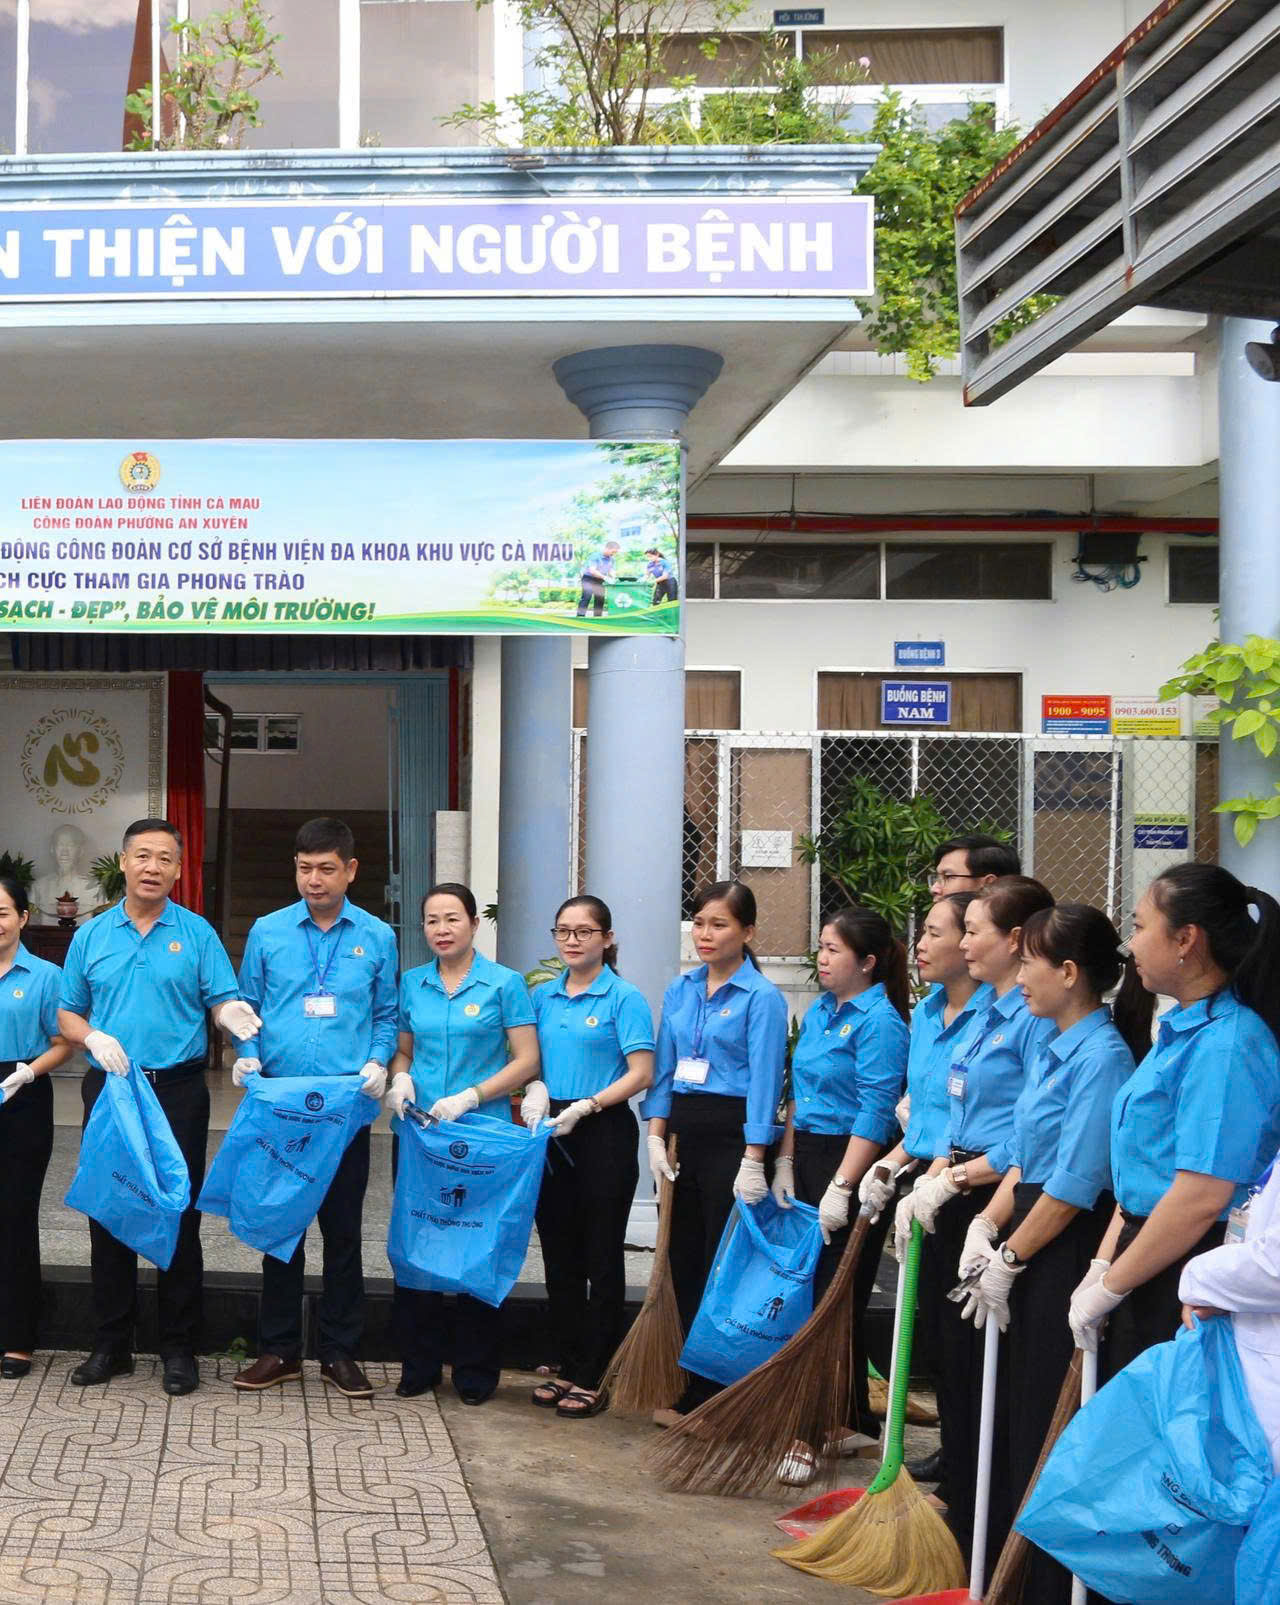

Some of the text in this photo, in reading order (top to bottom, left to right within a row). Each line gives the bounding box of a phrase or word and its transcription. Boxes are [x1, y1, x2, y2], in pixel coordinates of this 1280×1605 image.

[43, 213, 246, 287] THIỆN
[272, 211, 383, 275] VỚI
[410, 211, 619, 275] NGƯỜI
[647, 209, 833, 283] BỆNH
[21, 494, 260, 512] LIÊN ĐOÀN LAO ĐỘNG TỈNH CÀ MAU
[33, 515, 248, 529] CÔNG ĐOÀN PHƯỜNG AN XUYÊN
[1, 538, 50, 564] ĐỘNG
[56, 538, 105, 560] CÔNG
[111, 538, 161, 560] ĐOÀN
[168, 540, 192, 560] CƠ
[198, 536, 223, 560] SỞ
[228, 539, 277, 564] BỆNH
[284, 539, 325, 565] VIỆN
[330, 542, 354, 561] ĐA
[361, 542, 410, 561] KHOA
[416, 542, 453, 561] KHU
[460, 540, 495, 565] VỰC
[502, 539, 525, 561] CÀ
[533, 542, 574, 561] MAU
[27, 571, 67, 592] CỰC
[73, 572, 130, 589] THAM
[137, 572, 170, 589] GIA
[177, 573, 246, 590] PHONG
[253, 570, 305, 590] TRÀO
[136, 595, 184, 620] BẢO
[191, 597, 218, 624] VỆ
[222, 597, 267, 620] MÔI
[273, 597, 376, 621] TRƯỜNG!
[887, 685, 946, 706] BUỒNG BỆNH
[897, 707, 935, 719] NAM
[1047, 707, 1071, 716] 1900
[1081, 707, 1106, 716] 9095
